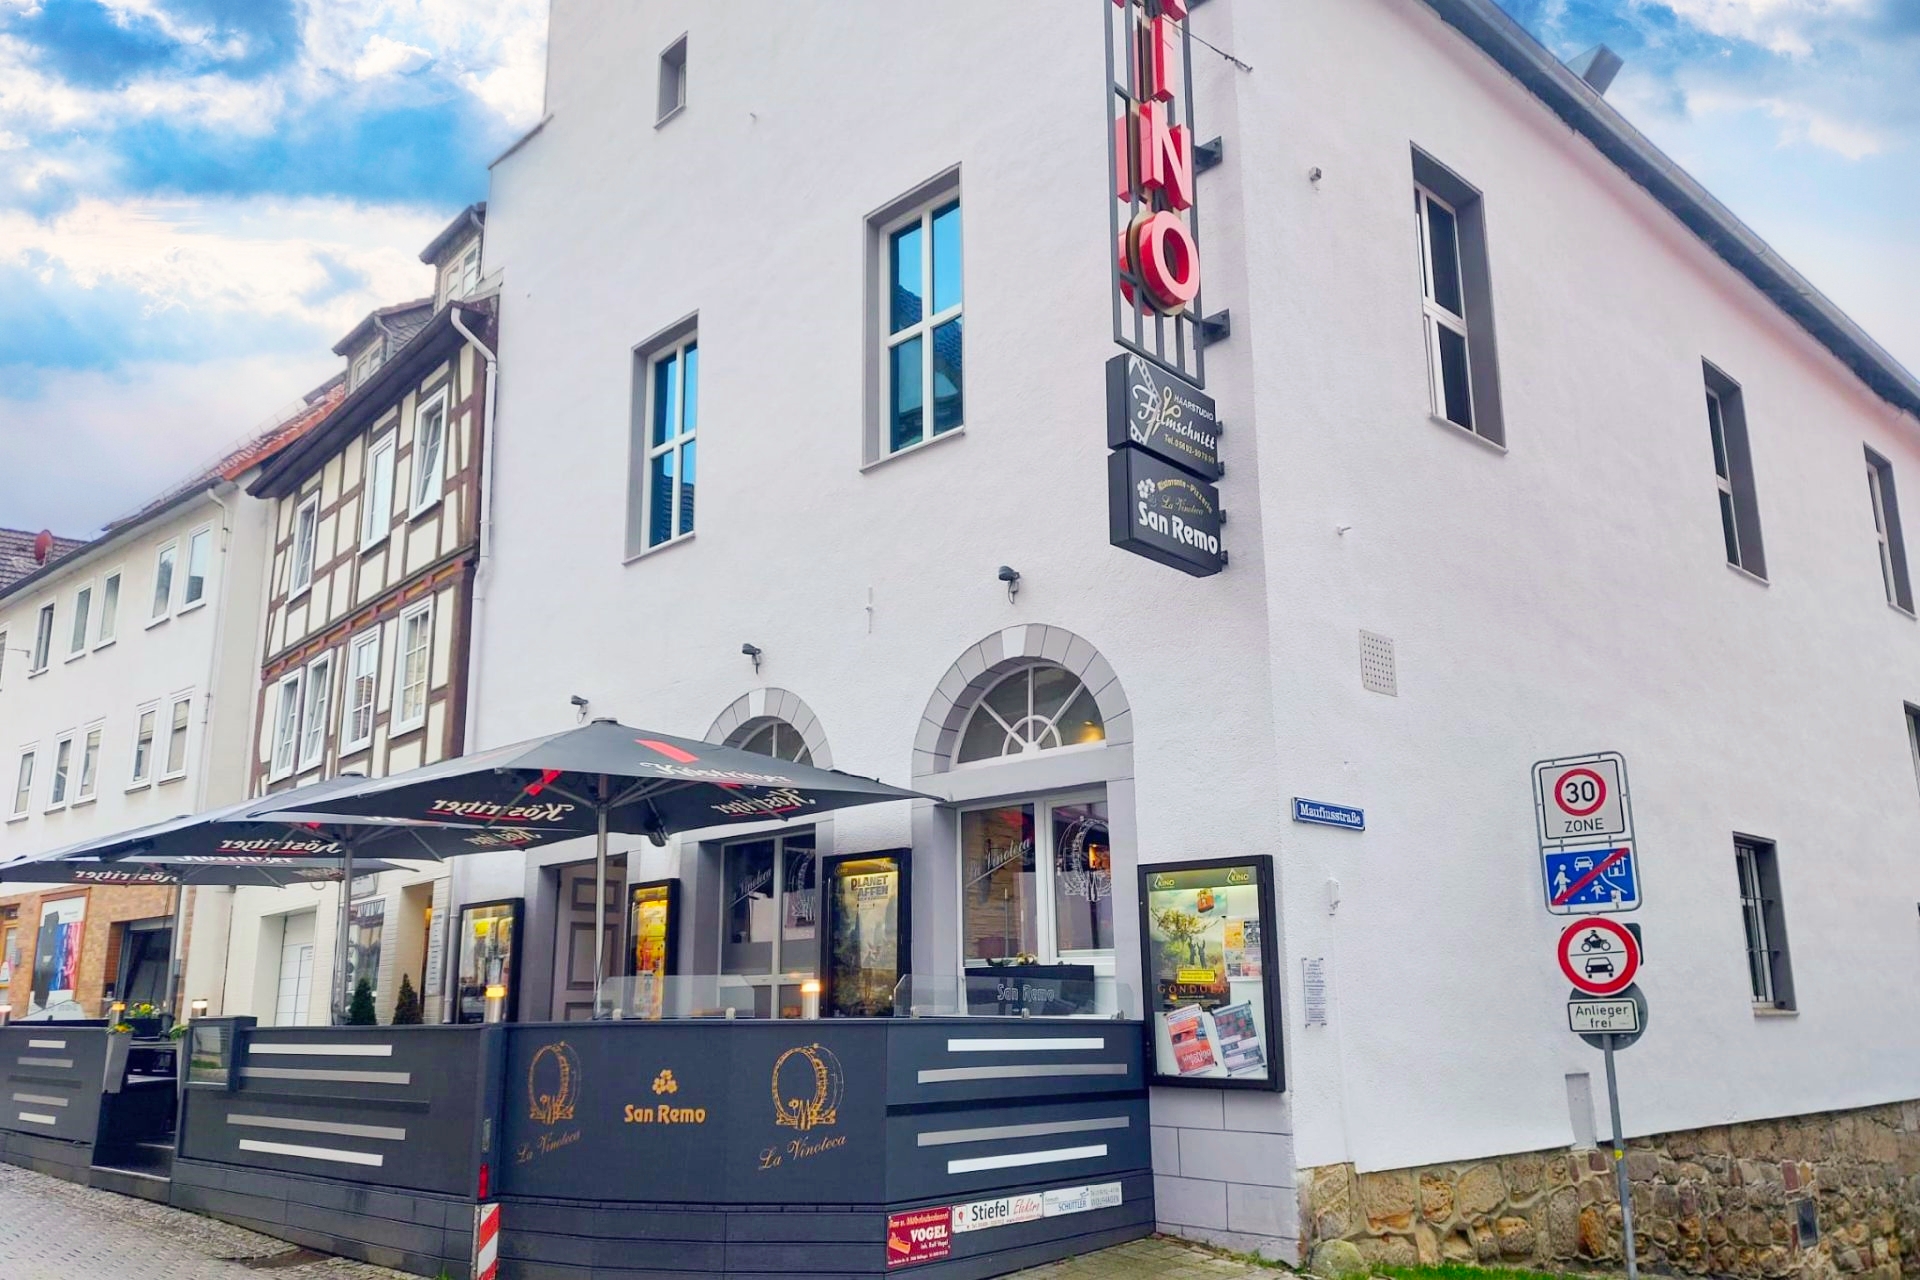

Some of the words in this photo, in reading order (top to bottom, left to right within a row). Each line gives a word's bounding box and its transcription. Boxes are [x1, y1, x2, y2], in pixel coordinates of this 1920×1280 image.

[1118, 0, 1200, 308] INO
[1173, 394, 1214, 421] HAARSTUDIO
[1138, 501, 1169, 536] San
[1171, 514, 1218, 555] Remo
[1565, 780, 1596, 804] 30
[1564, 817, 1605, 834] ZONE
[996, 982, 1019, 1001] San
[1022, 983, 1055, 1002] Remo
[1575, 1004, 1629, 1019] Anlieger
[1590, 1017, 1612, 1029] frei
[624, 1103, 654, 1123] San
[657, 1103, 706, 1125] Remo
[758, 1146, 782, 1171] La
[787, 1135, 846, 1161] Vinoteca
[971, 1199, 1010, 1222] Stiefel
[910, 1224, 949, 1243] VOGEL
